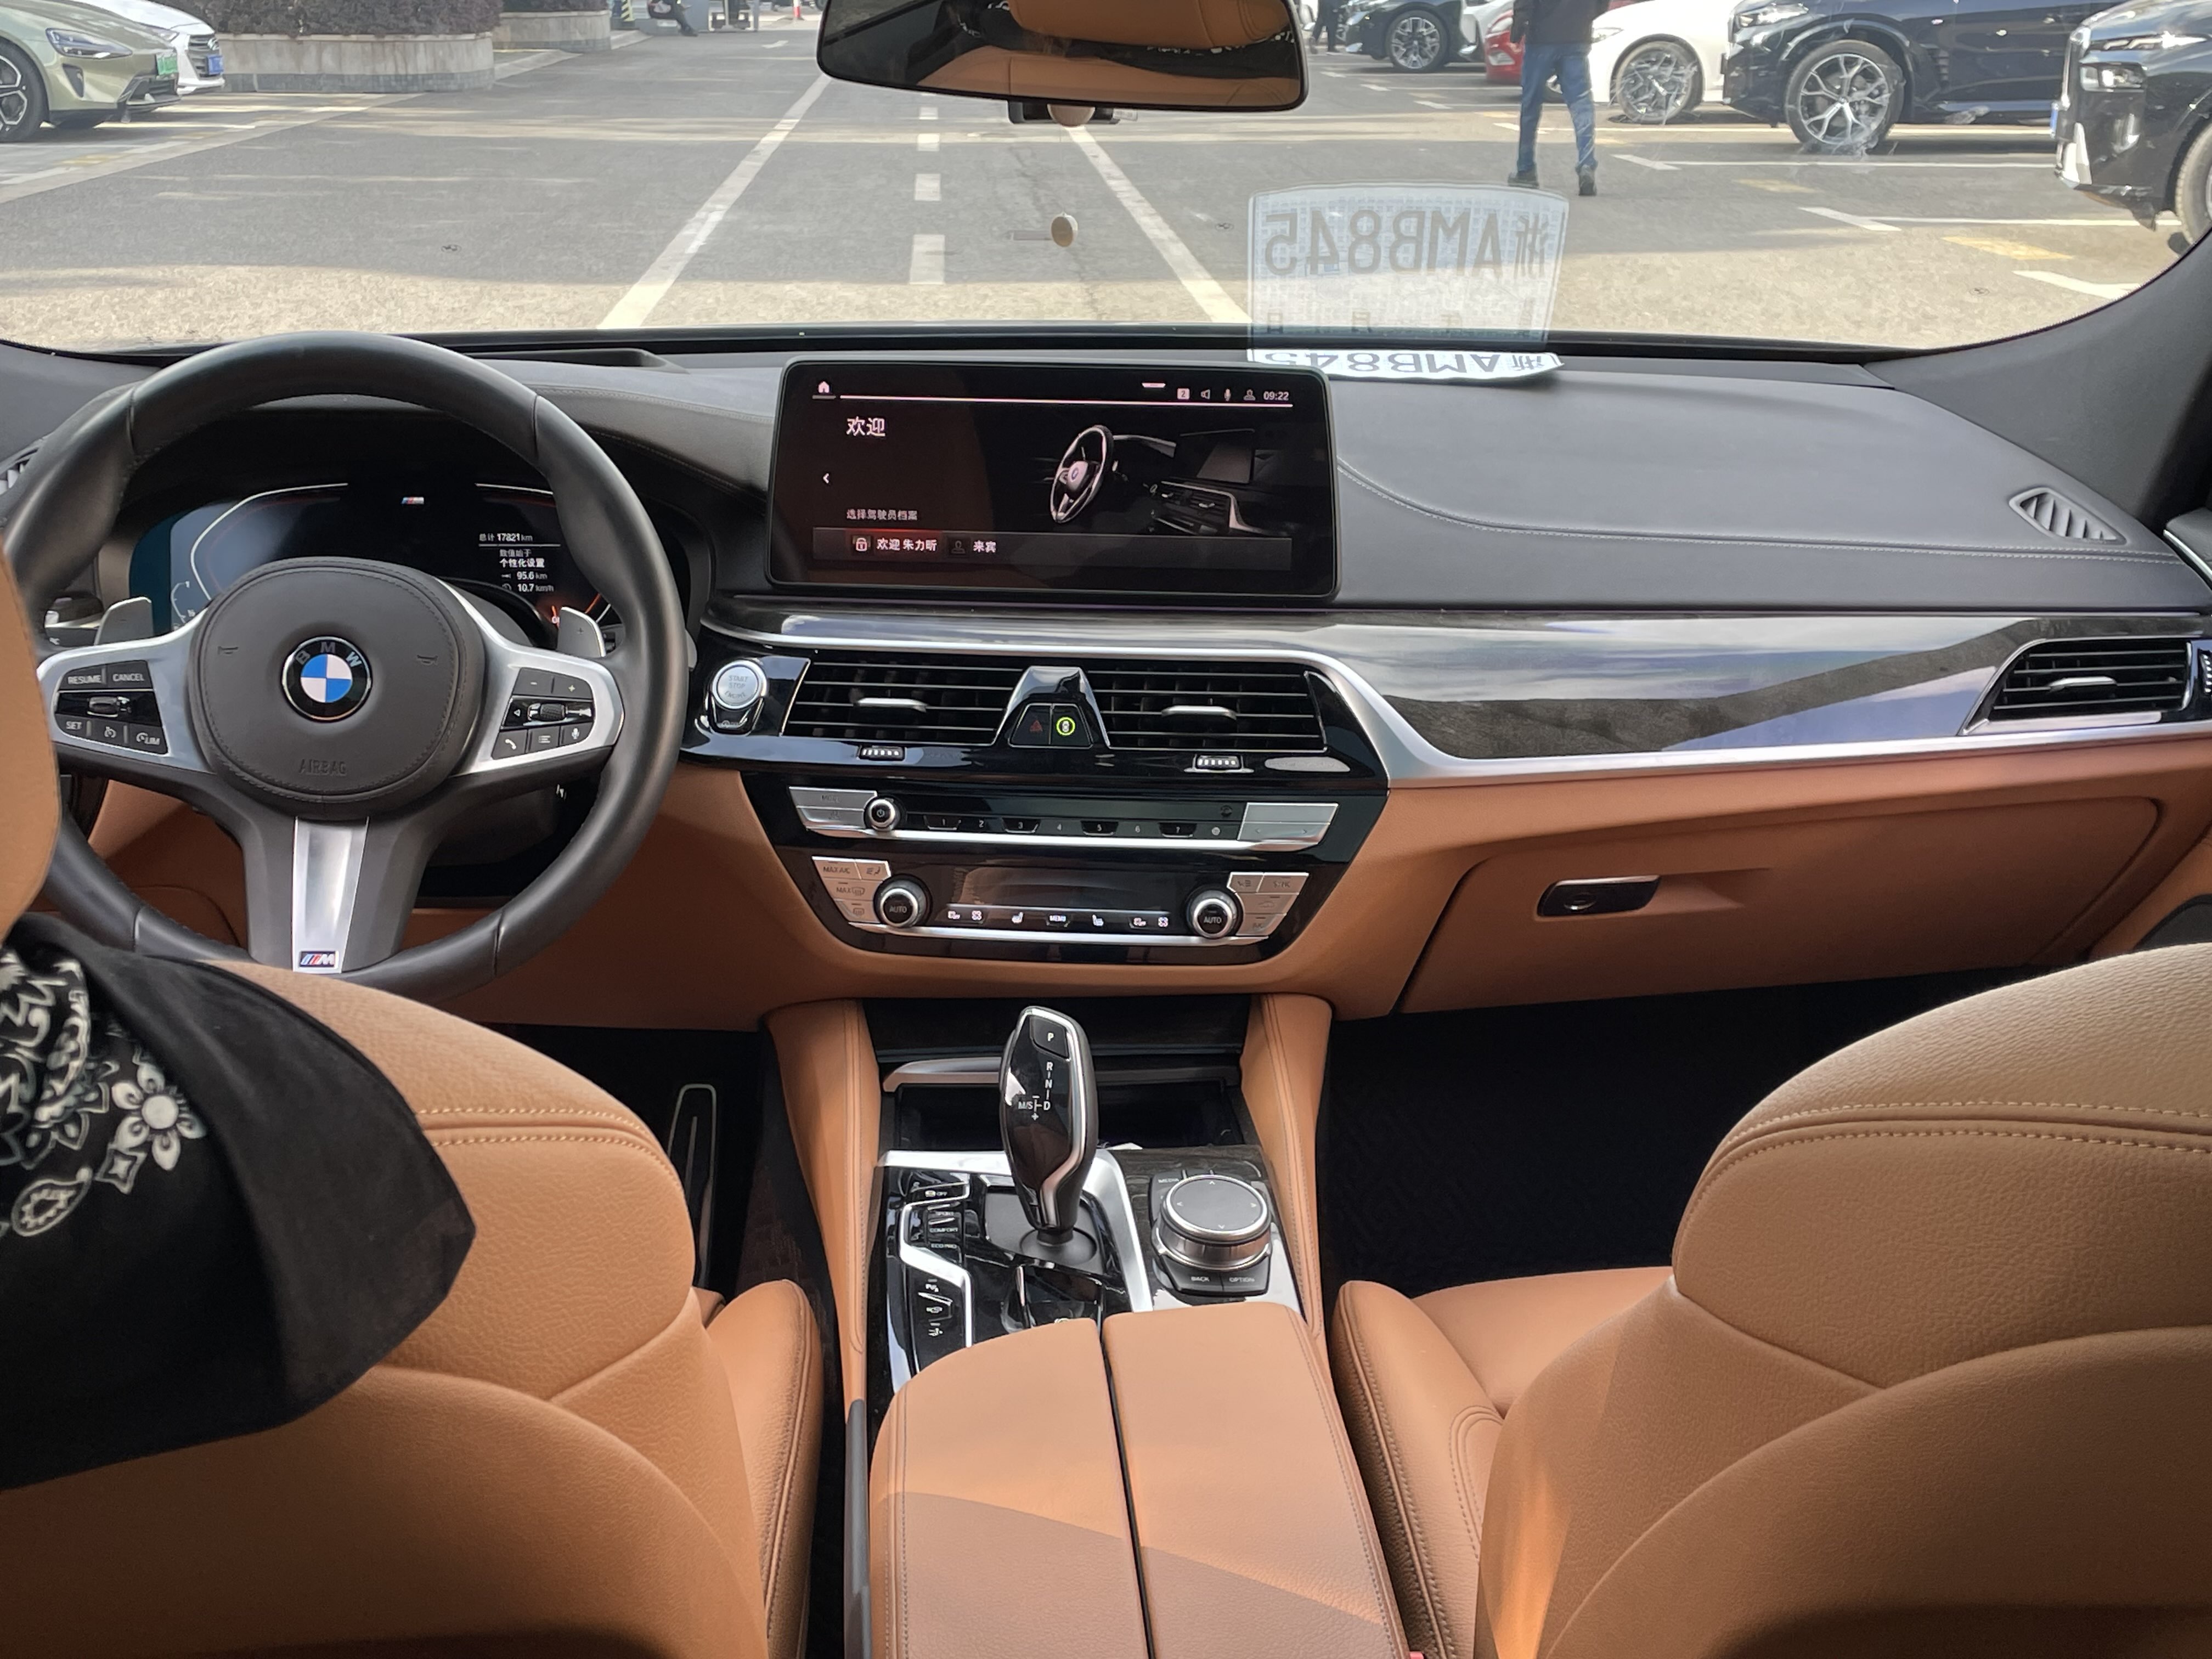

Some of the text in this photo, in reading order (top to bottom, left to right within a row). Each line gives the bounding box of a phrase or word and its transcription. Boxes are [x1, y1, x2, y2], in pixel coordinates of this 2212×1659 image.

[1263, 391, 1289, 401] 09:22
[845, 416, 887, 437] 欢迎
[847, 509, 918, 521] 选择驾驶员档案
[496, 533, 521, 541] 17821
[876, 537, 901, 551] 欢迎
[973, 540, 997, 553] 来宾
[499, 558, 545, 568] 个性化设置
[517, 571, 535, 580] 95.6
[517, 583, 535, 592] 10.7
[295, 641, 363, 668] BMW
[67, 674, 102, 685] RESUME
[112, 673, 145, 682] CANCEL
[65, 721, 82, 730] SET
[298, 759, 347, 776] AIRBAG
[889, 905, 907, 913] AUTO
[1204, 916, 1222, 924] AUTO
[1047, 1032, 1054, 1041] P
[1046, 1062, 1053, 1071] R
[1045, 1079, 1053, 1089] N
[1043, 1101, 1051, 1111] D
